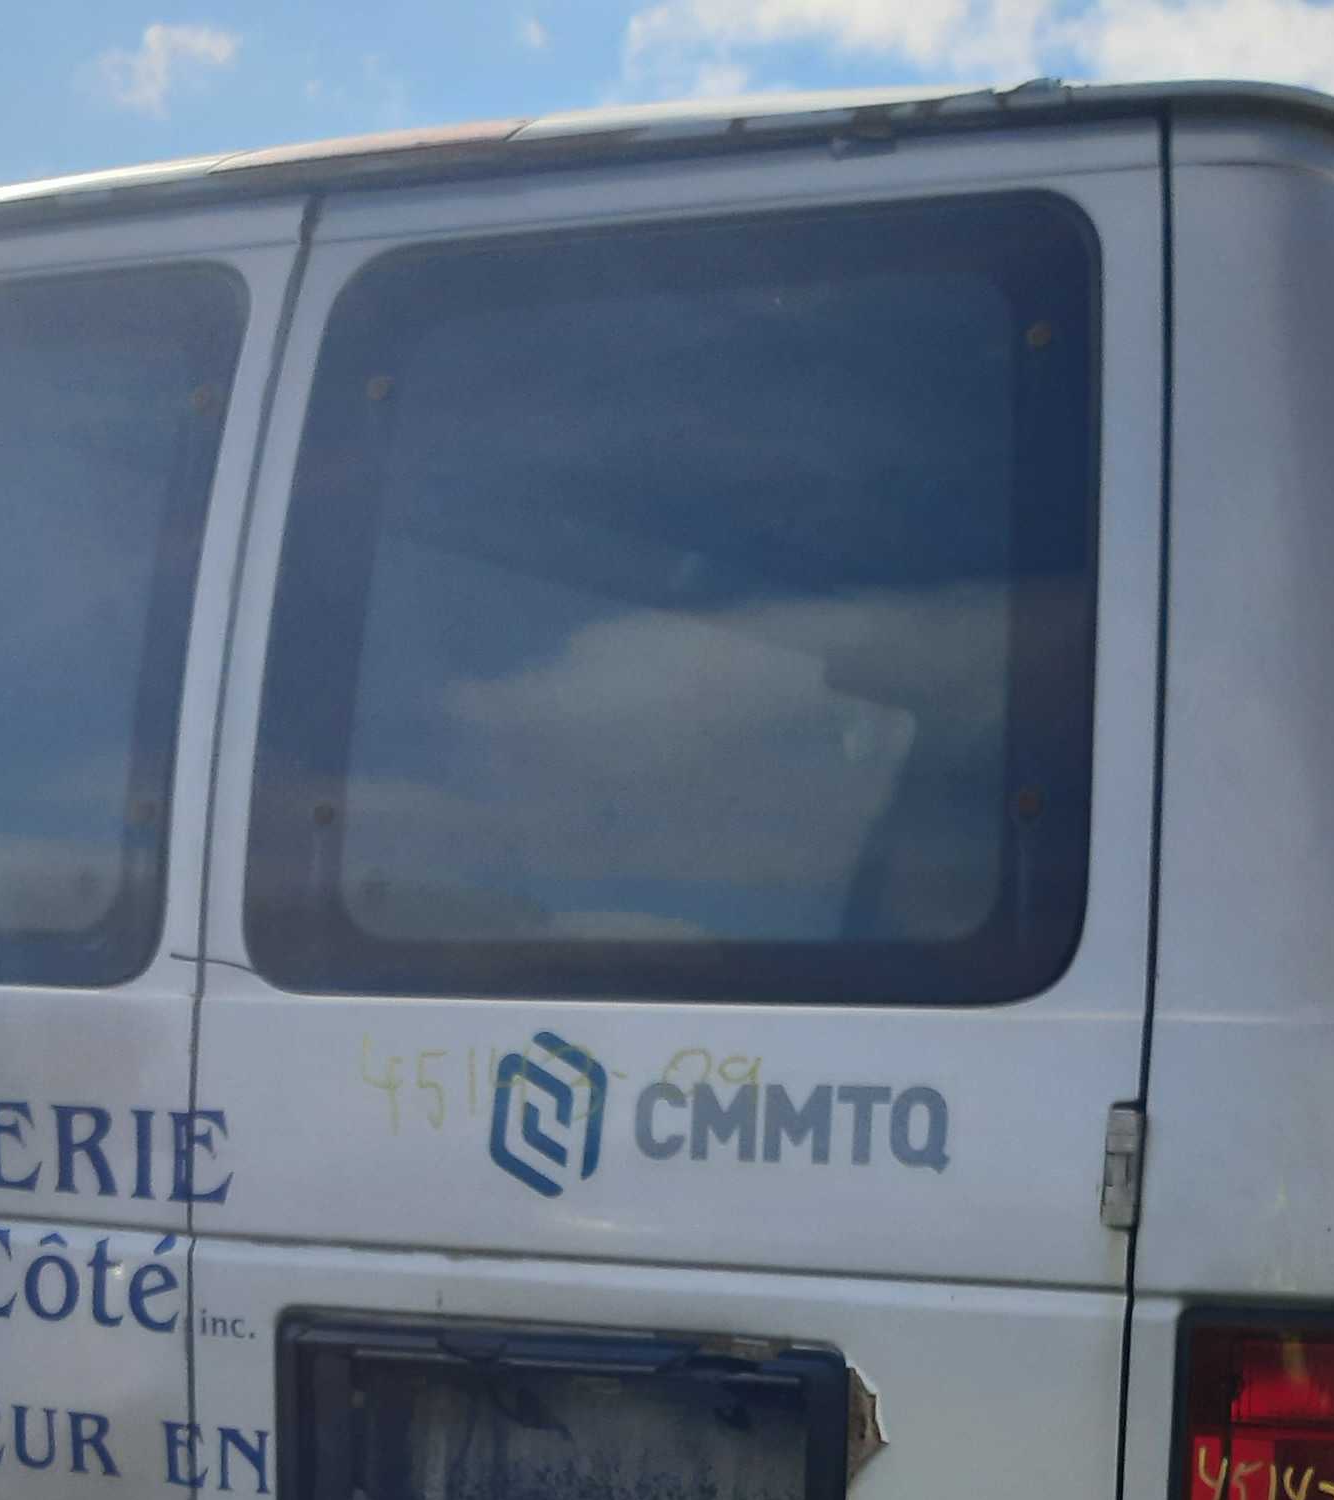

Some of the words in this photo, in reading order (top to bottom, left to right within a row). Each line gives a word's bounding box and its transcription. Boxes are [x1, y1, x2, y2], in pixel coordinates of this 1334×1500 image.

[634, 1081, 950, 1175] CMMTQ
[199, 1308, 257, 1340] inc.
[163, 1420, 273, 1495] EN
